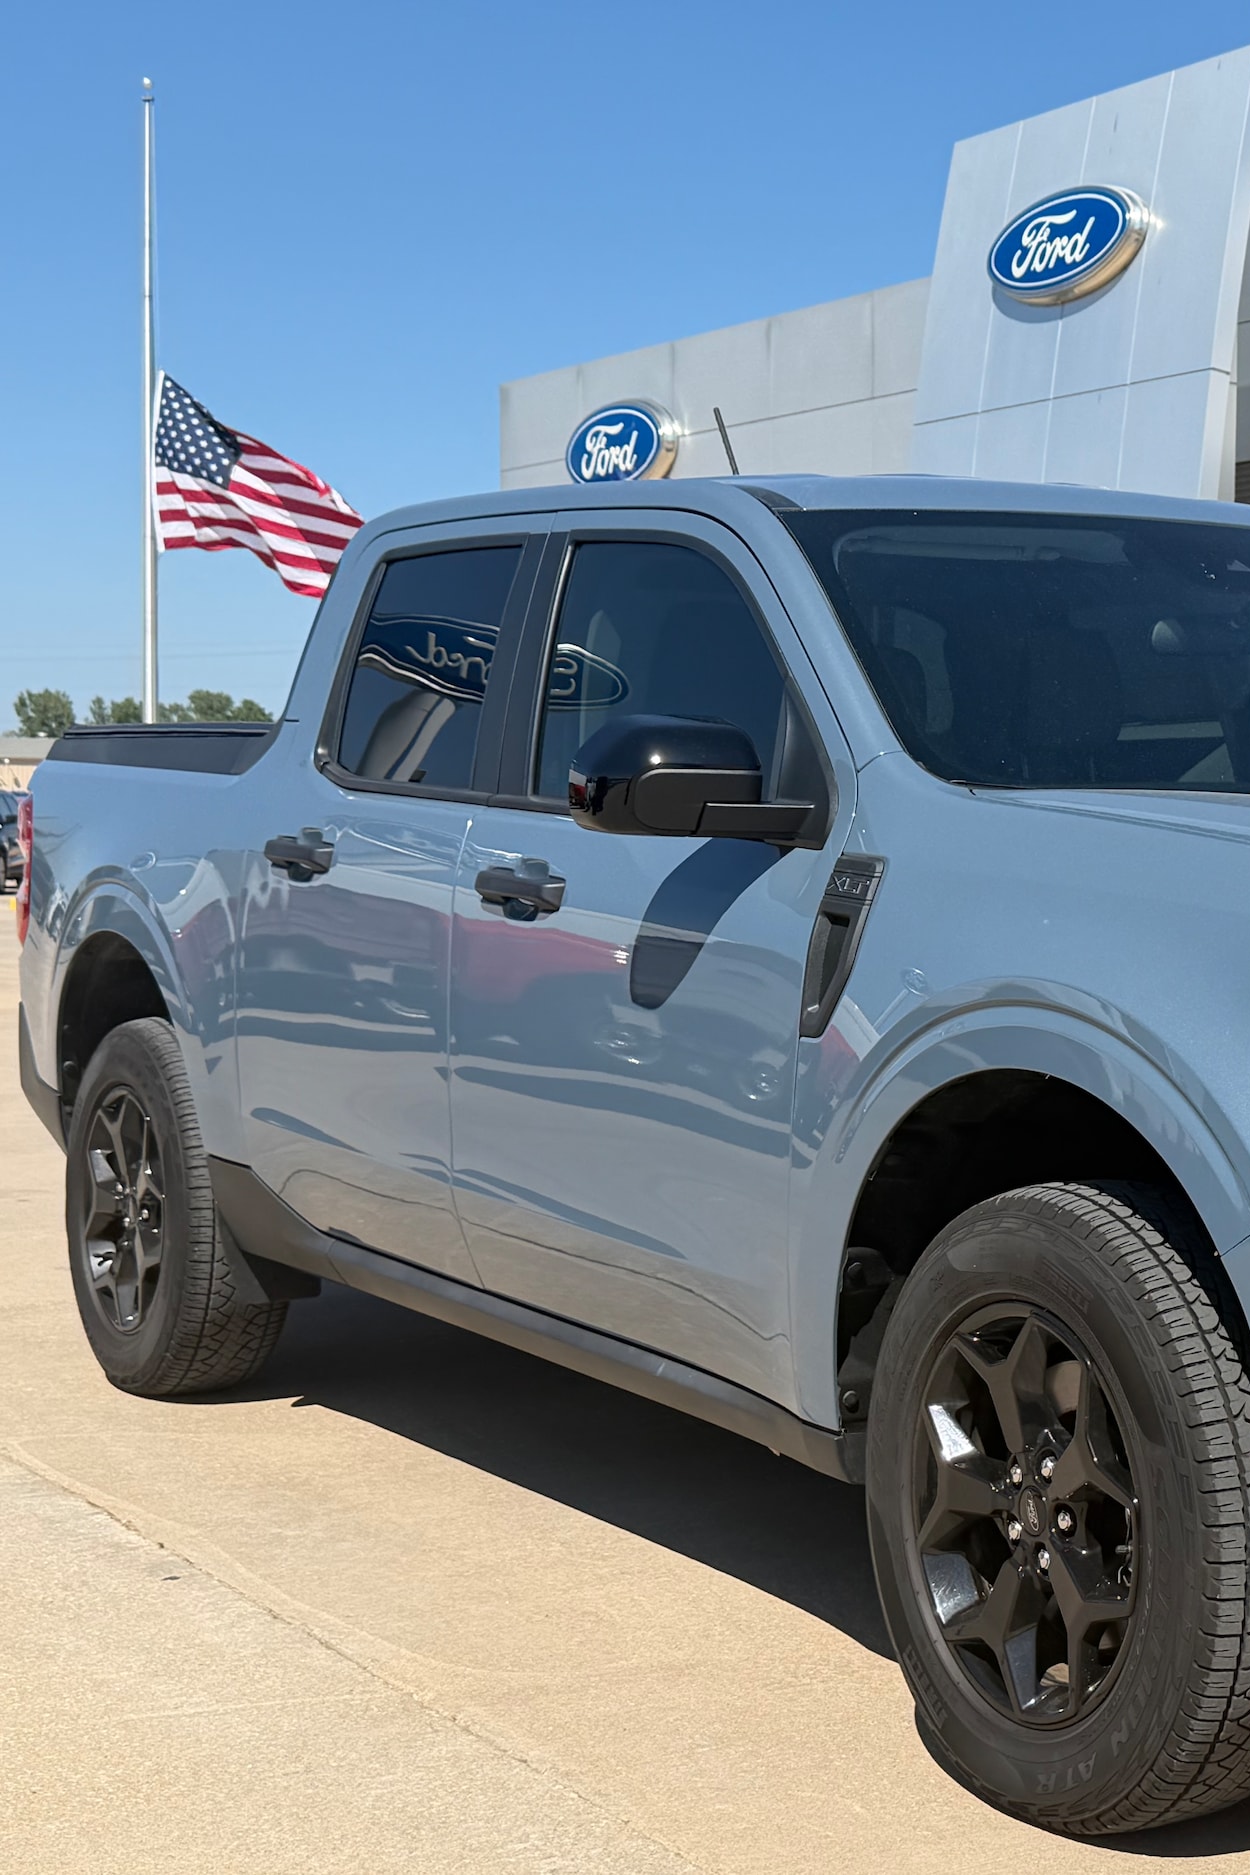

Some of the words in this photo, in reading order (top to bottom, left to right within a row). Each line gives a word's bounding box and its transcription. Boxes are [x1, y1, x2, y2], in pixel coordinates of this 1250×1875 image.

[1011, 209, 1096, 279] Ford
[581, 422, 638, 480] Ford
[827, 875, 870, 895] XLT
